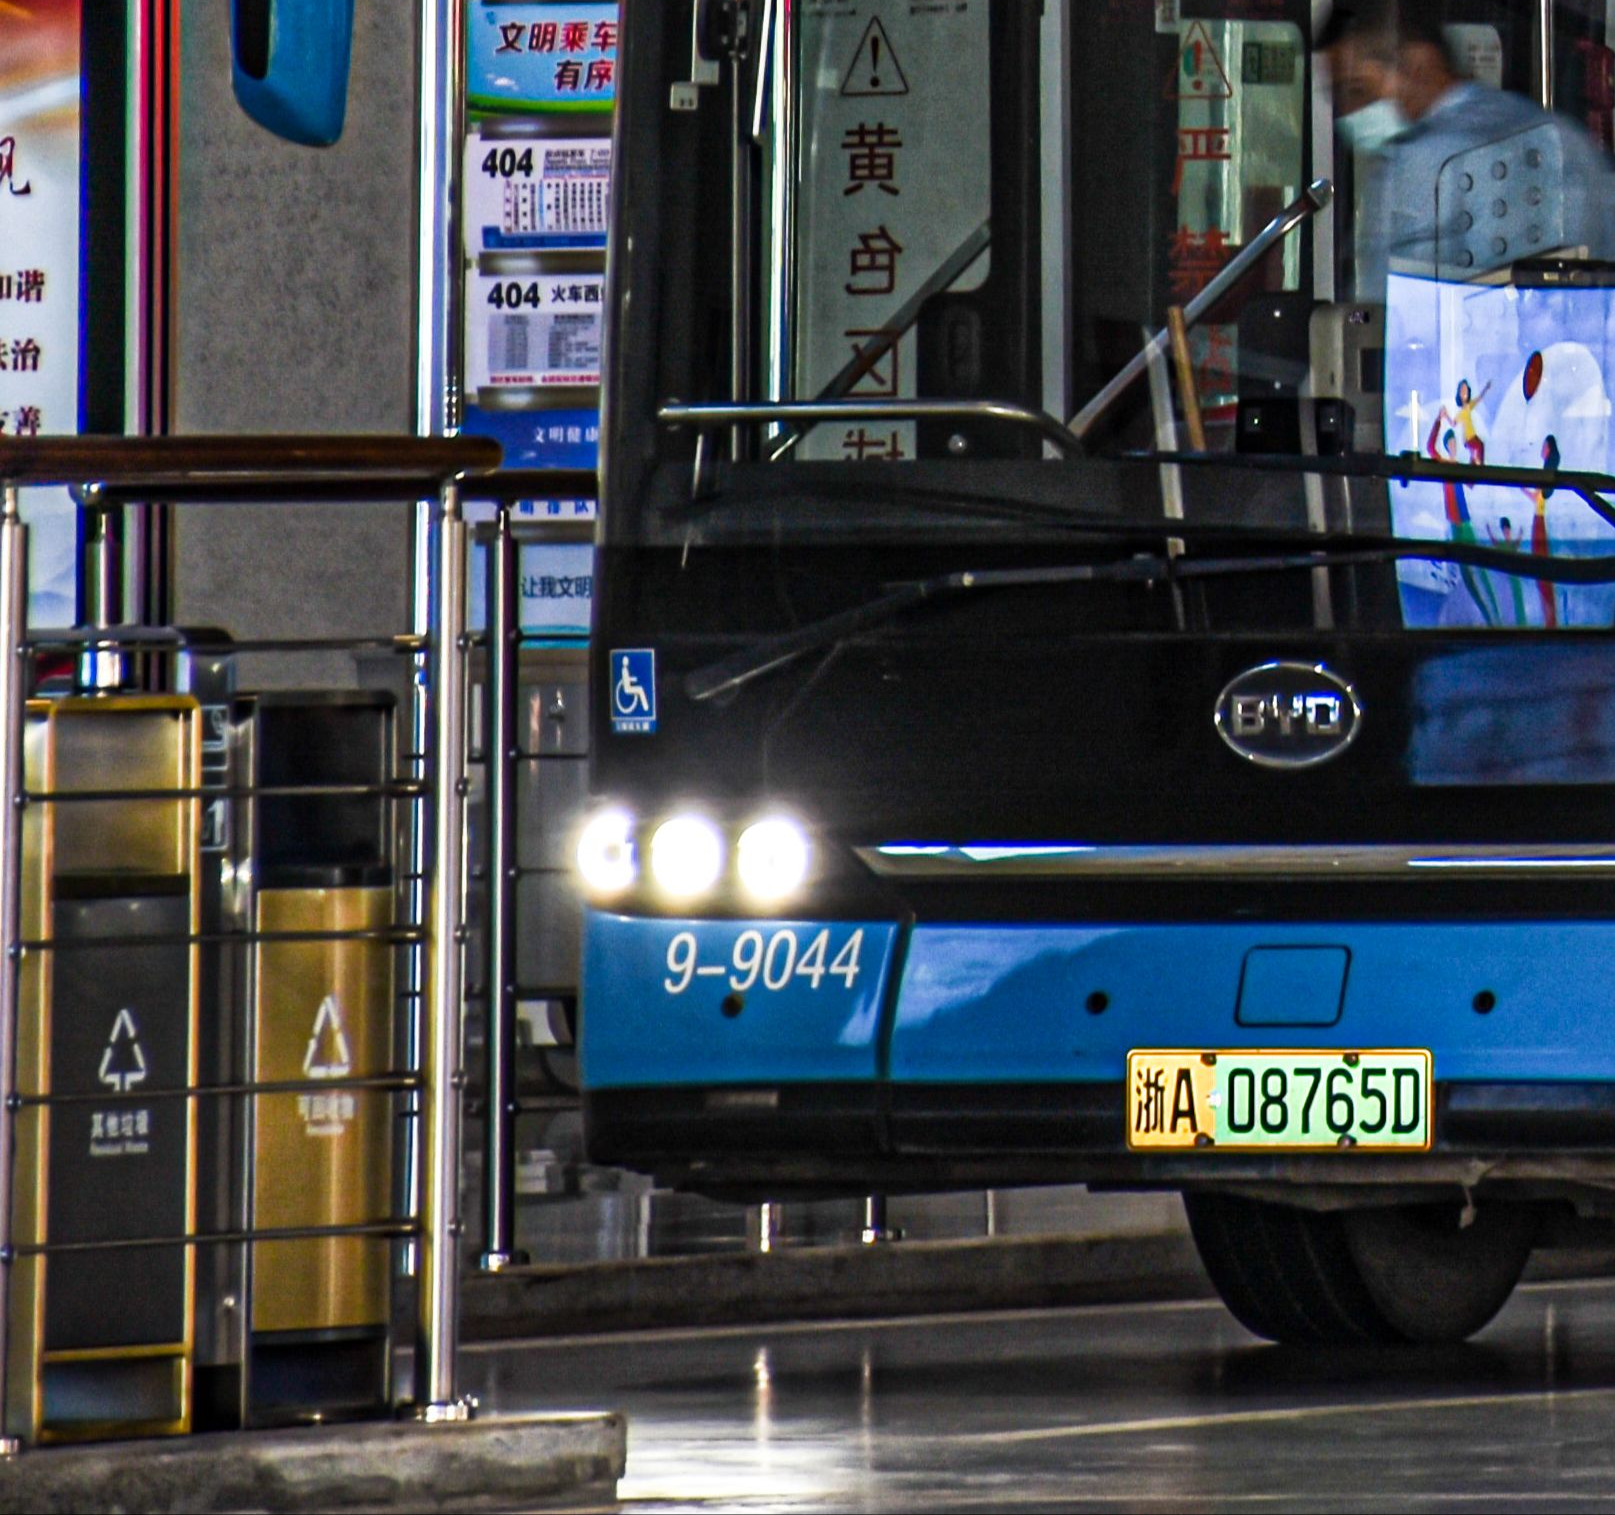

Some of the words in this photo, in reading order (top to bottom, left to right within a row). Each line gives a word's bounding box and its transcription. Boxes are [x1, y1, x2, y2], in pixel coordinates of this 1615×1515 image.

[496, 22, 617, 54] 文明乘车
[554, 60, 614, 90] 有序
[482, 147, 533, 178] 404
[487, 282, 540, 309] 404
[1231, 694, 1341, 735] BYD
[664, 928, 864, 995] 9-9044
[1135, 1067, 1199, 1134] 浙A
[1227, 1067, 1421, 1134] 08765D
